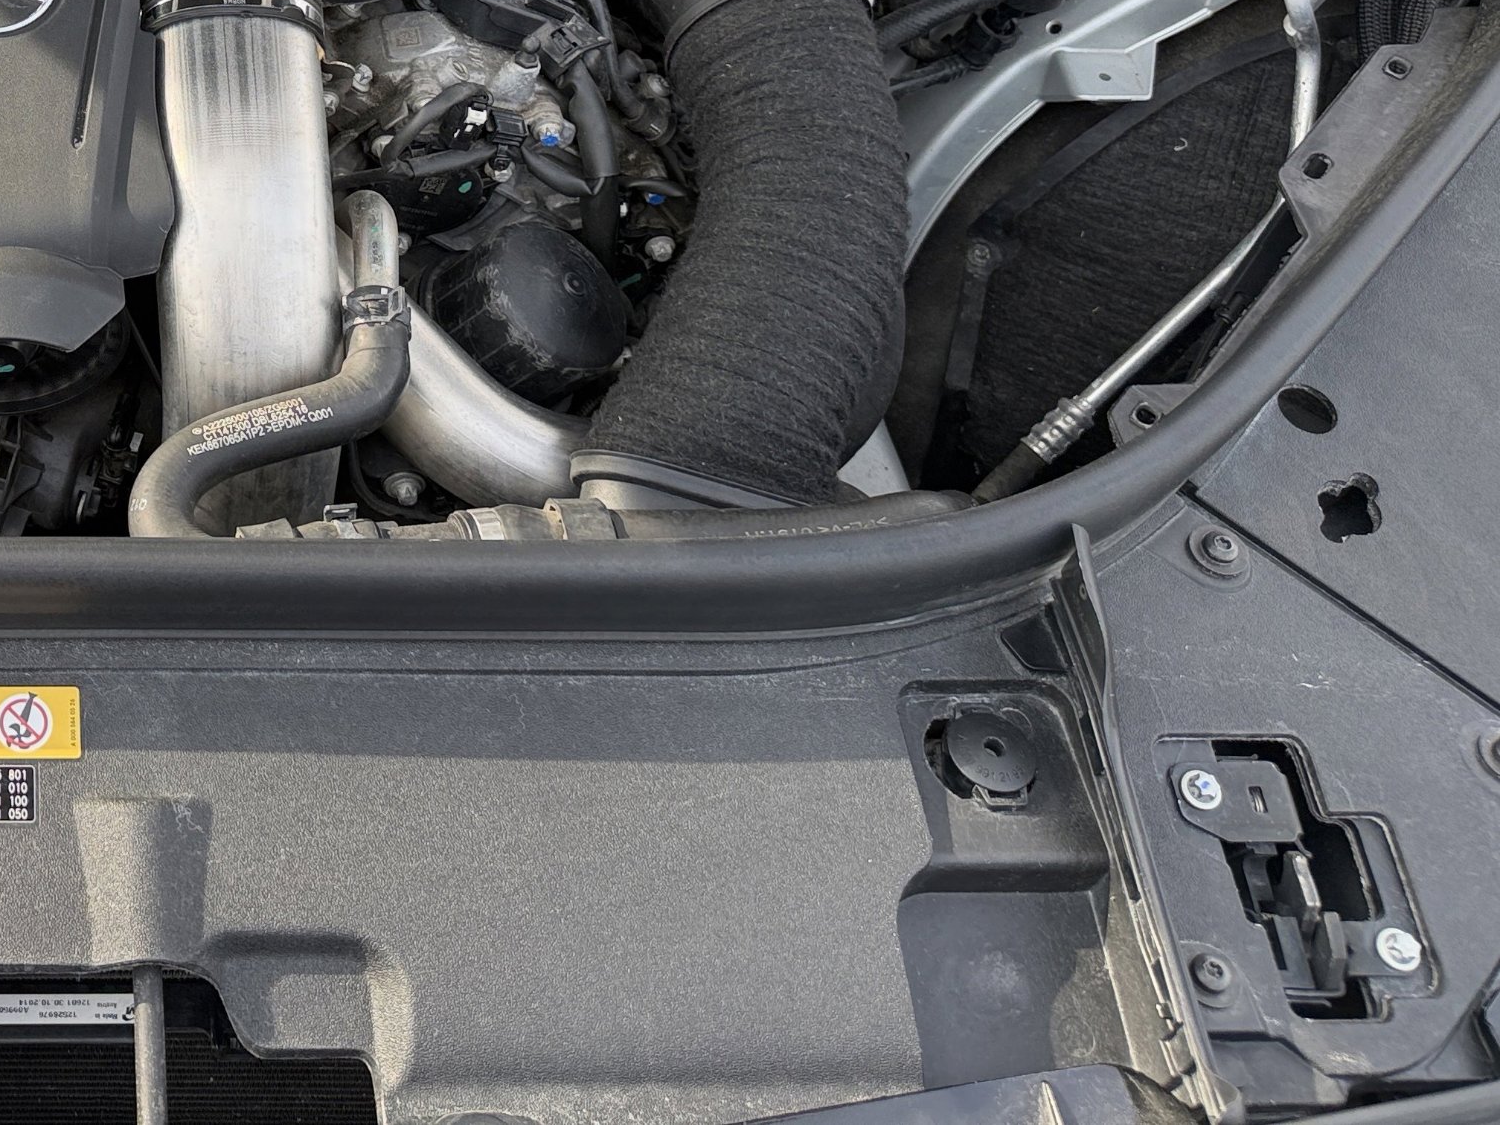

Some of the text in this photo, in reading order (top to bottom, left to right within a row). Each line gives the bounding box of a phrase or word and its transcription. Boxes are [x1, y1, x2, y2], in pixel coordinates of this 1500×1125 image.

[9, 769, 26, 780] 801
[9, 782, 28, 793] 010
[10, 795, 28, 806] 100
[9, 809, 28, 819] 050
